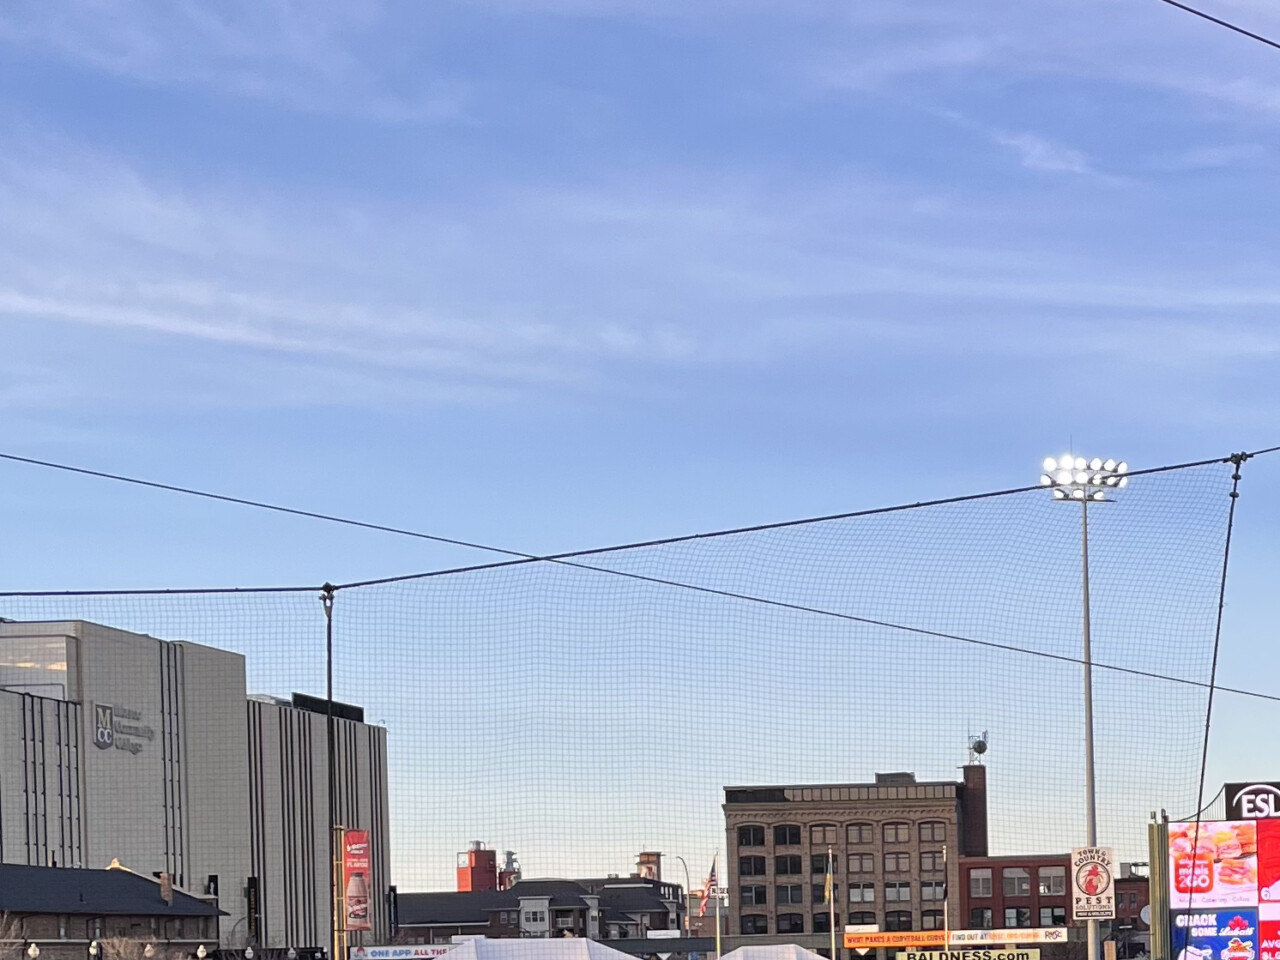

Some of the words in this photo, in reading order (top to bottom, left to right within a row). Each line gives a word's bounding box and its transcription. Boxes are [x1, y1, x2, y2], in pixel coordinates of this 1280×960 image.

[1078, 849, 1100, 857] TOWN
[1074, 854, 1112, 867] COUNTRY
[1179, 875, 1210, 887] 2GO
[1260, 886, 1270, 900] 6
[1075, 896, 1112, 904] PEST
[1191, 927, 1217, 937] SOME
[392, 949, 411, 957] APP
